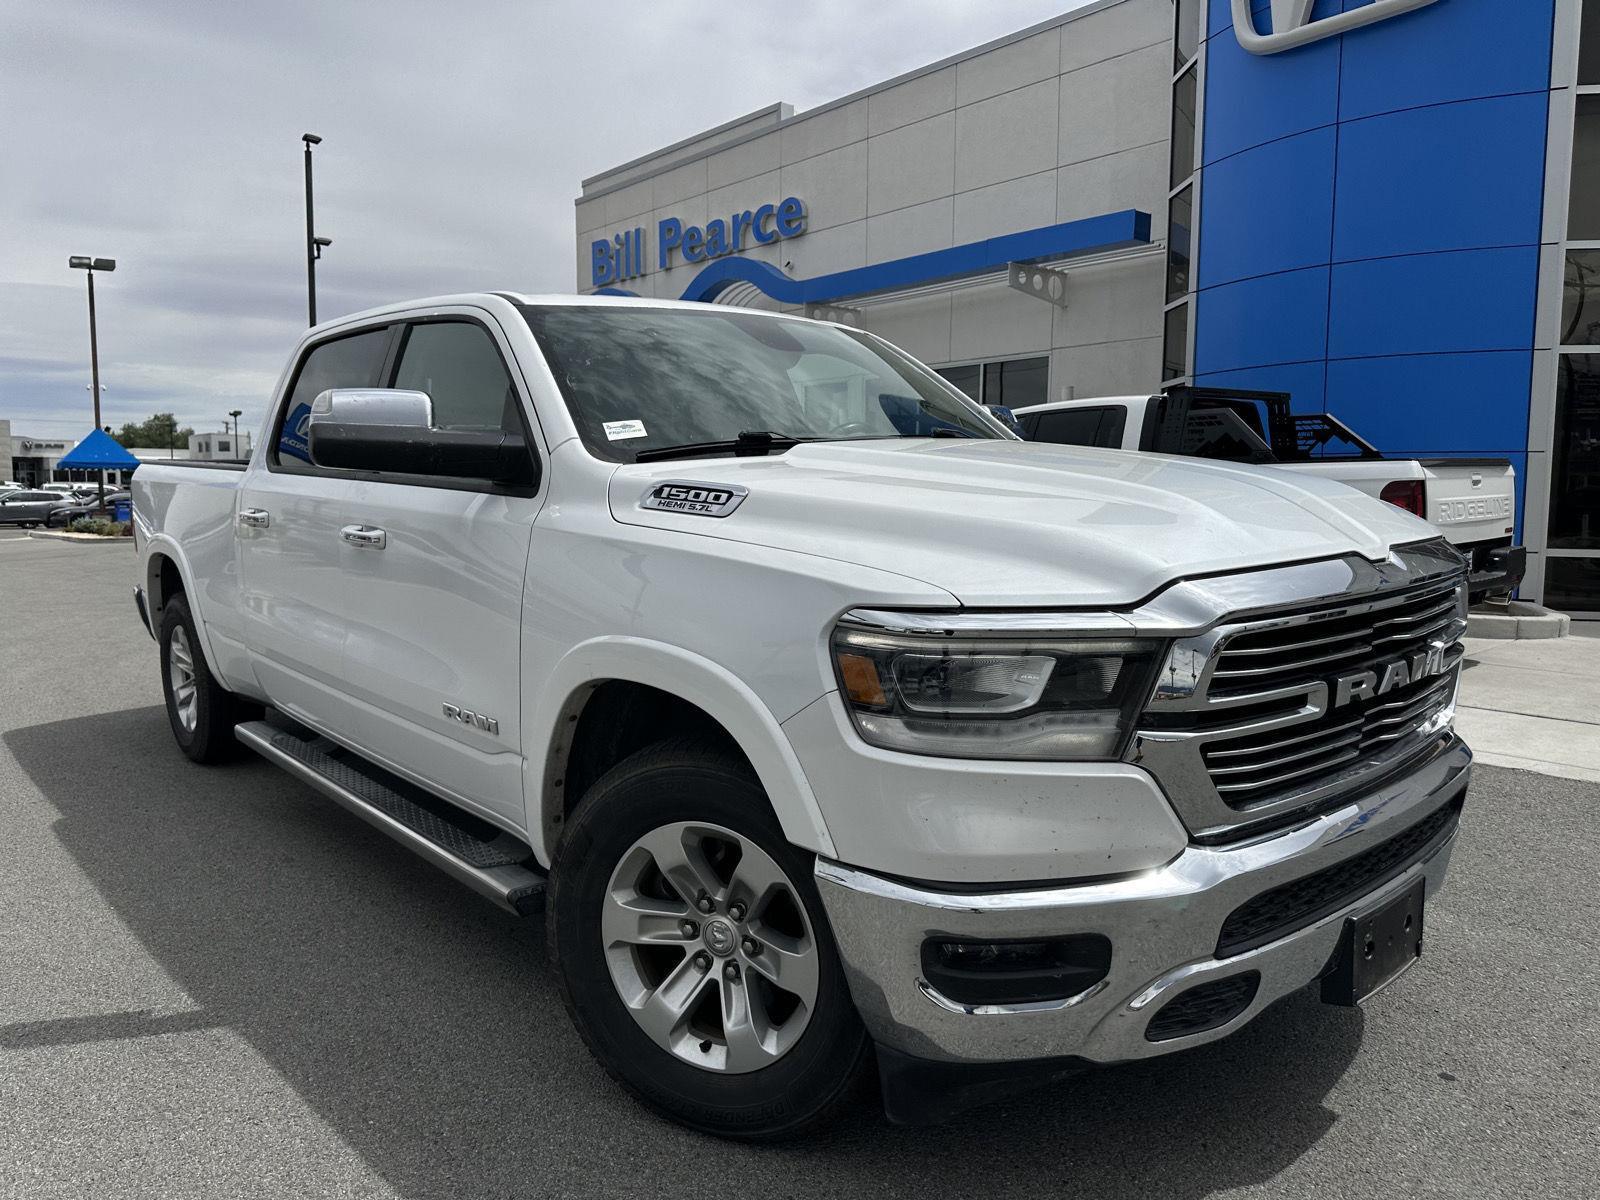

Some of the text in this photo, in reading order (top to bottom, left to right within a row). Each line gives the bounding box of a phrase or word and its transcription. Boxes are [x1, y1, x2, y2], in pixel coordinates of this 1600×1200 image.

[591, 197, 805, 287] Bill Pearce
[657, 500, 713, 512] HEMI 5.7L
[660, 486, 729, 504] 1500
[1438, 498, 1510, 522] RIDGELINE
[1335, 646, 1444, 708] RAM
[442, 702, 499, 735] RAM
